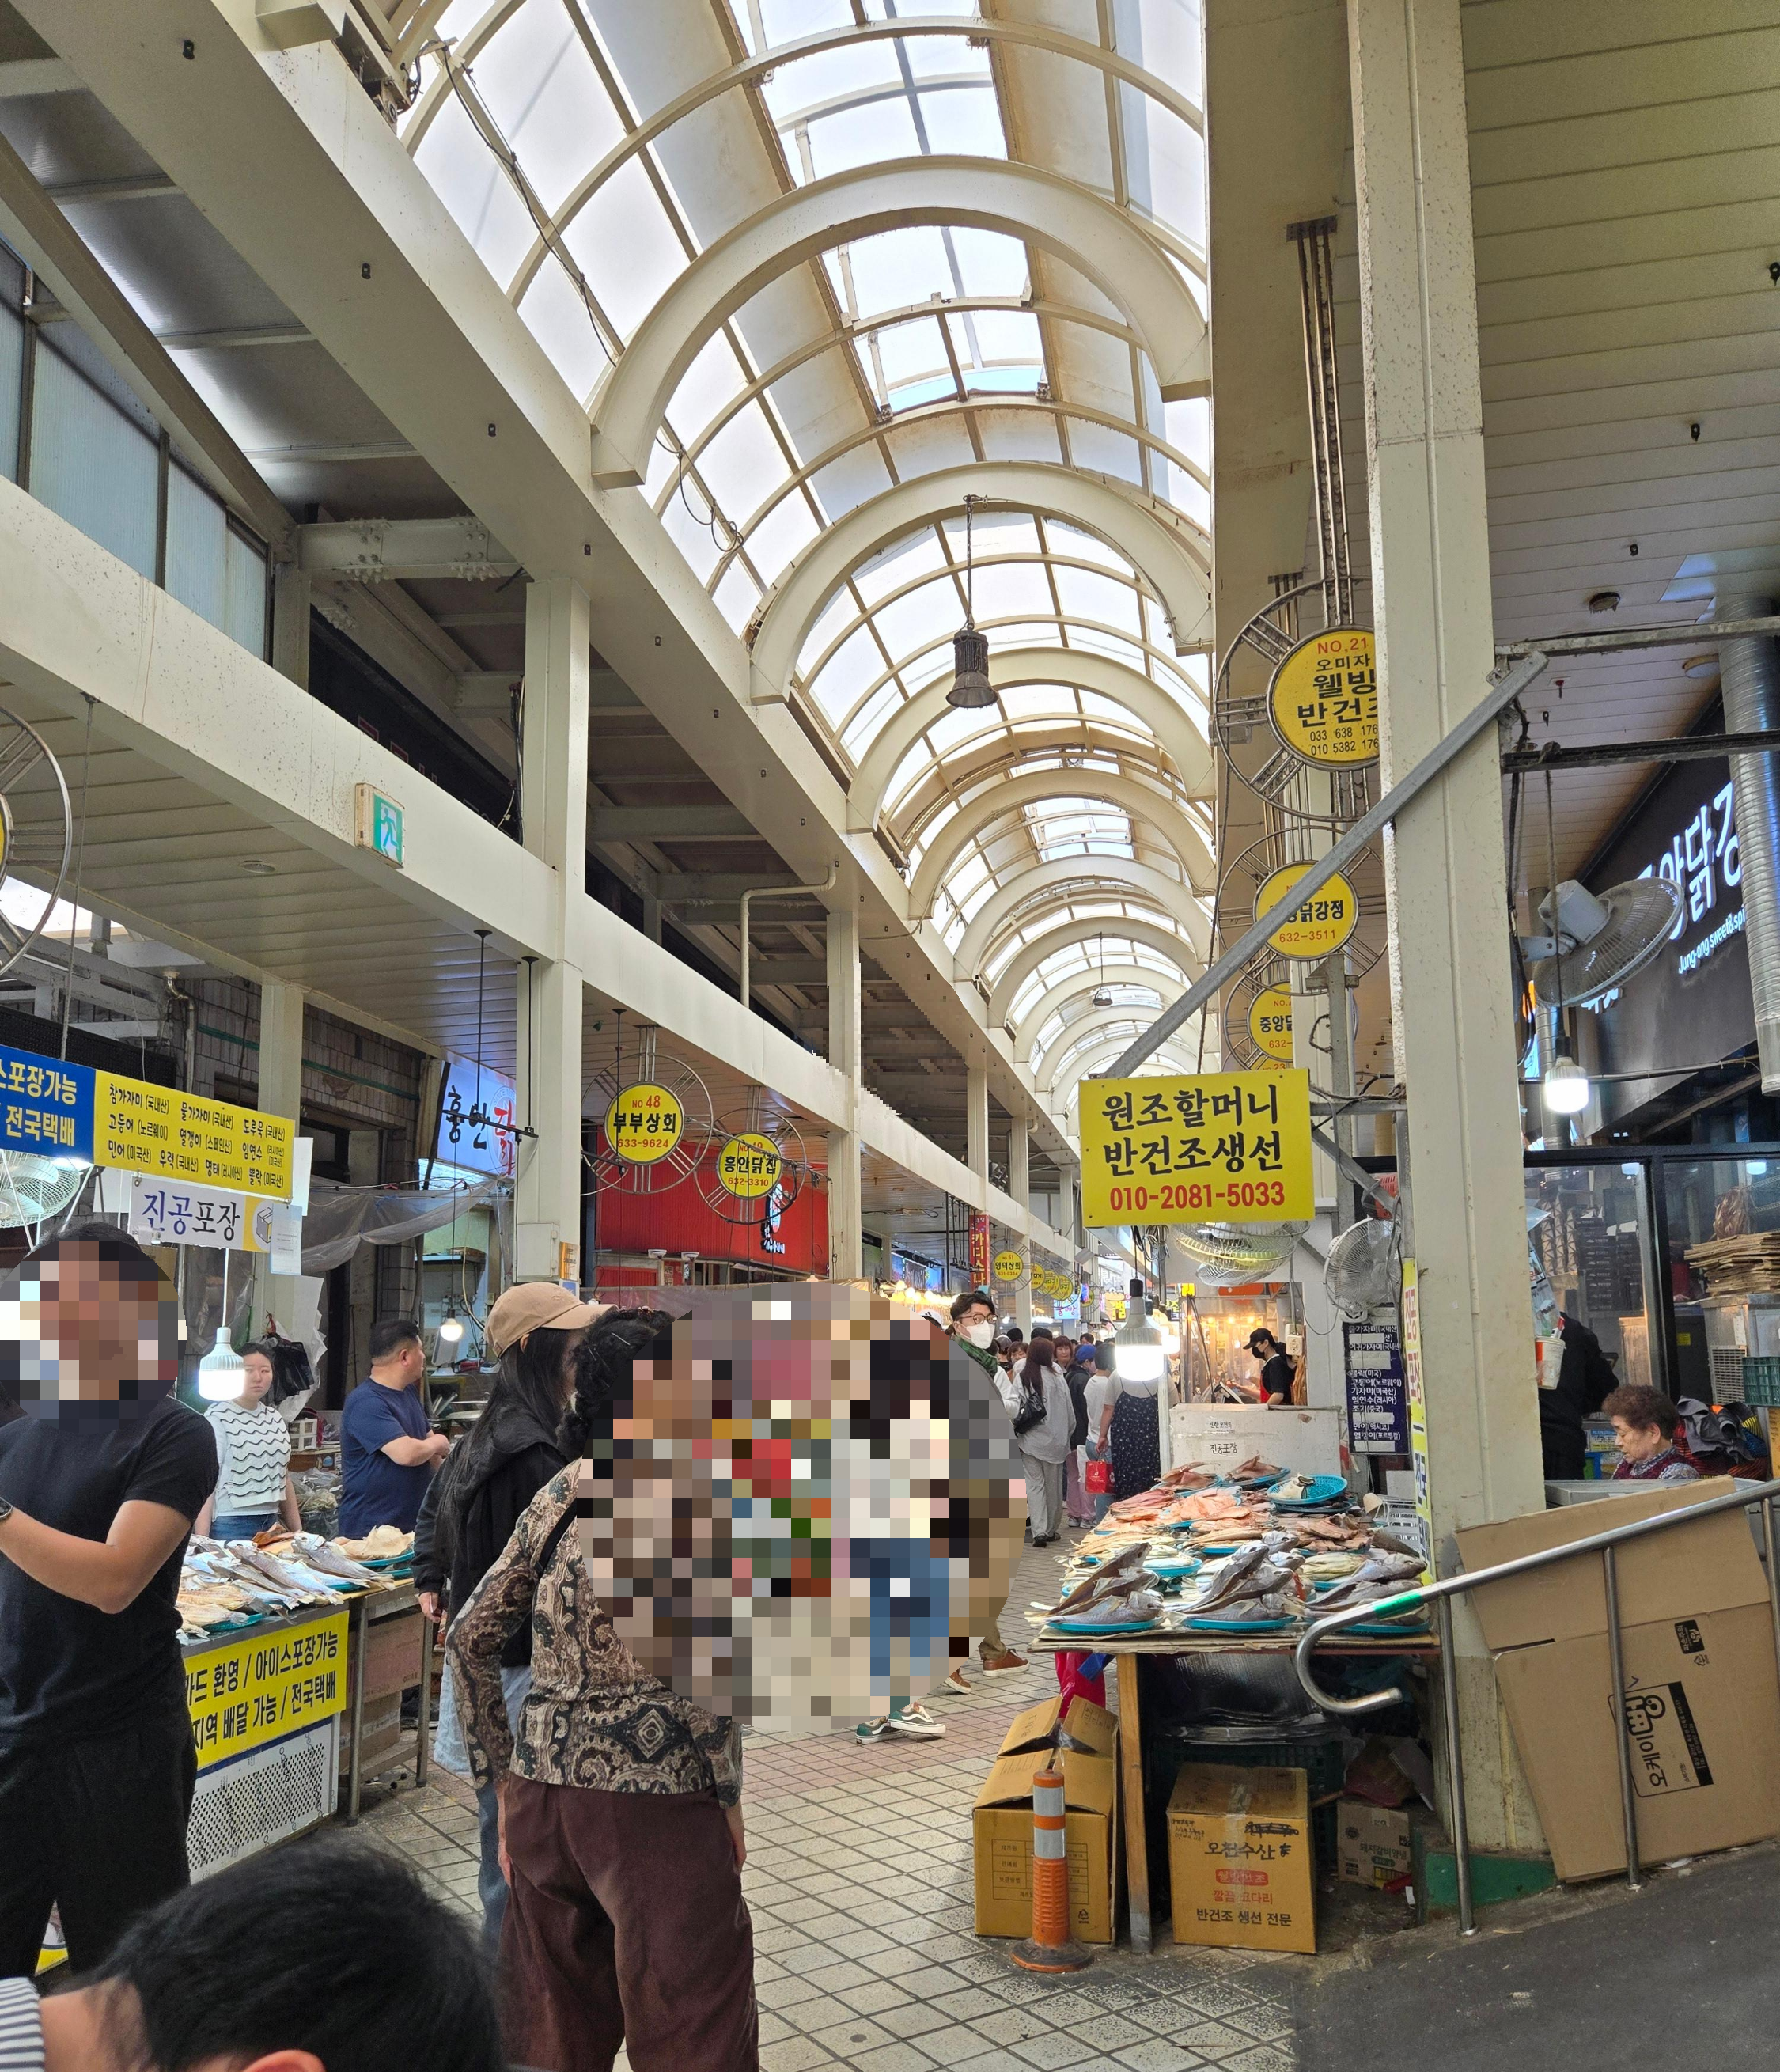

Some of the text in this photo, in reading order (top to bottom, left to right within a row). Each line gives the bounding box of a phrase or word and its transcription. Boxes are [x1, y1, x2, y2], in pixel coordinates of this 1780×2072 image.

[1317, 637, 1368, 654] NO.21
[1316, 653, 1370, 672] 오미자
[1312, 669, 1377, 699] 웰빙
[1310, 730, 1327, 742] 033
[1335, 726, 1353, 739] 638
[1311, 744, 1328, 756] 010
[1333, 741, 1356, 754] 5382
[1270, 900, 1343, 923] 닭강정
[1279, 929, 1335, 942] 632-3511
[646, 1095, 661, 1108] 48
[1102, 1084, 1278, 1131] 원조할머니
[109, 1083, 285, 1142] 참가자미 (국내산) 물가자미 (국내산) 도루묵 (국내산)
[6, 1106, 74, 1146] 전국택배
[613, 1113, 676, 1133] 부부상회
[109, 1113, 133, 1134] 고등어
[138, 1119, 168, 1141] (노르웨이)
[242, 1142, 262, 1161] 임연수
[617, 1138, 669, 1148] 633-9624
[1103, 1130, 1283, 1177] 반건조생선
[108, 1140, 125, 1158] 민어
[127, 1144, 151, 1164] (미국산)
[160, 1150, 174, 1169] 우럭
[176, 1153, 198, 1172] (국내산)
[206, 1159, 219, 1177] 명태
[264, 1171, 283, 1188] (미국산)
[725, 1155, 776, 1174] 흥안닭집
[728, 1177, 769, 1186] 632-3310
[1110, 1181, 1285, 1211] 010-2081-5033
[142, 1190, 240, 1241] 진공포장
[1352, 1396, 1397, 1405] 임연수(러시아)
[1210, 1442, 1237, 1454] 진공포장
[1676, 1625, 1689, 1652] 파손주의
[214, 1658, 239, 1698] 환영
[256, 1631, 339, 1681] 아이스포장가능
[223, 1701, 249, 1739] 배달
[253, 1694, 277, 1728] 가능
[291, 1670, 336, 1714] 전국택배
[1214, 1890, 1273, 1904] 깔끔 코다리
[1197, 1908, 1292, 1926] 반건조 생선 전문
